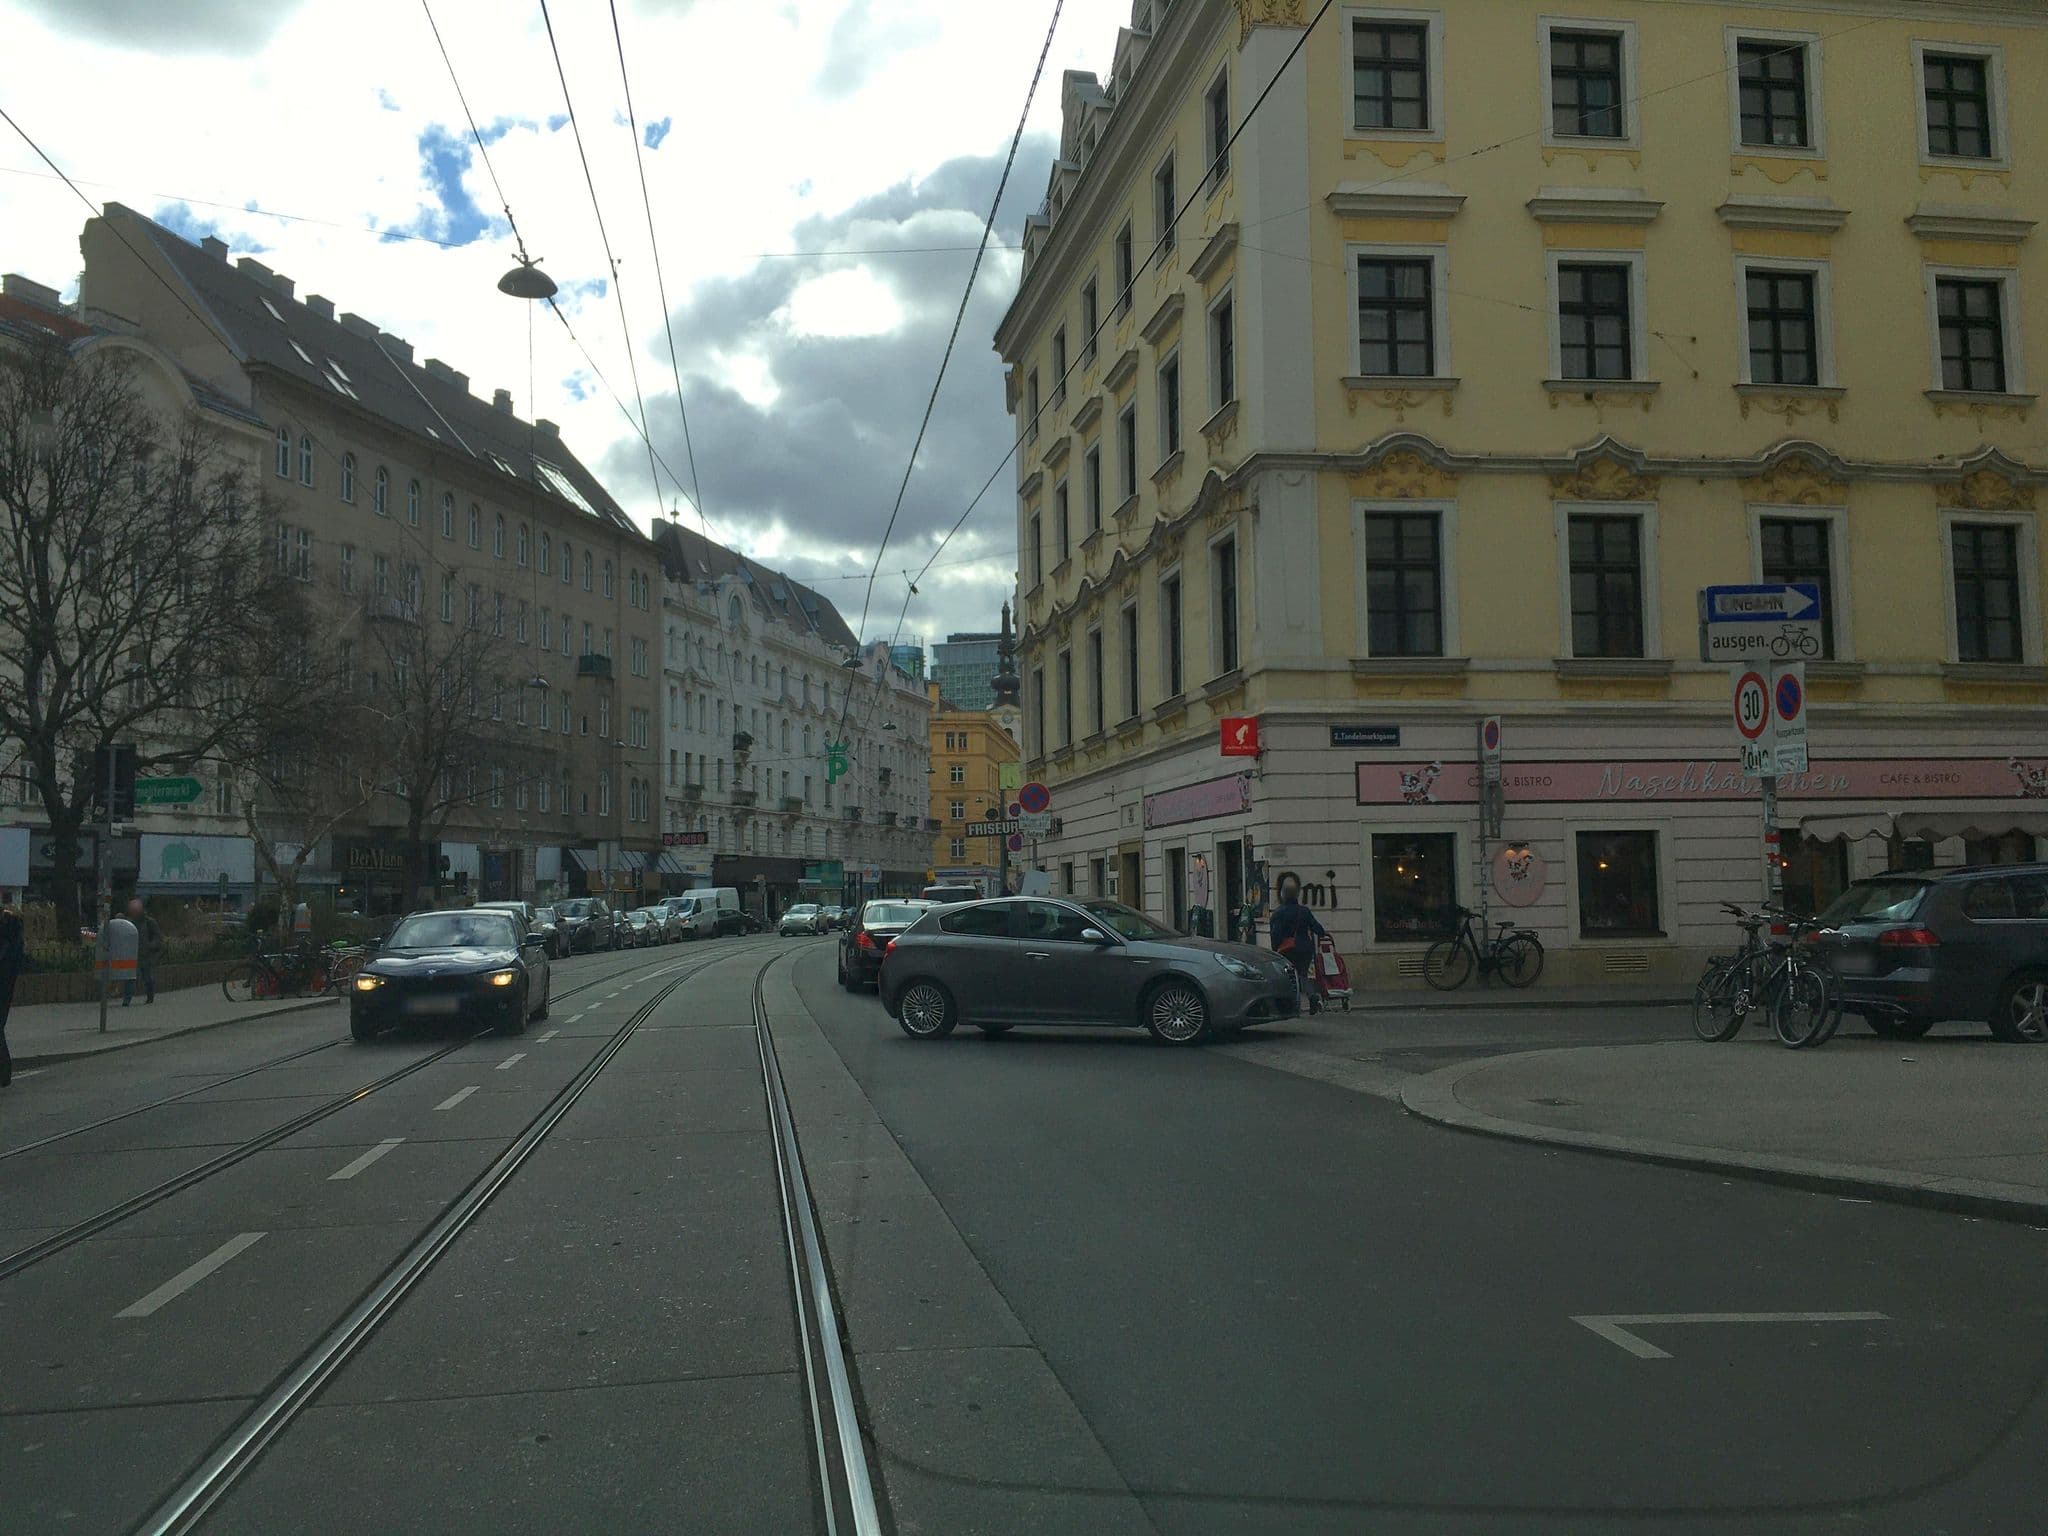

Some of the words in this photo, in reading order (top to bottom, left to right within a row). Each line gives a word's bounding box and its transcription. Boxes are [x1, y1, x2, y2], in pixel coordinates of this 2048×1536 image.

[1713, 635, 1769, 652] ausgen.
[1743, 690, 1760, 721] 30
[1514, 776, 1553, 787] BISTRO
[1924, 773, 1961, 784] BISTRO
[968, 822, 1019, 836] FRISEUR
